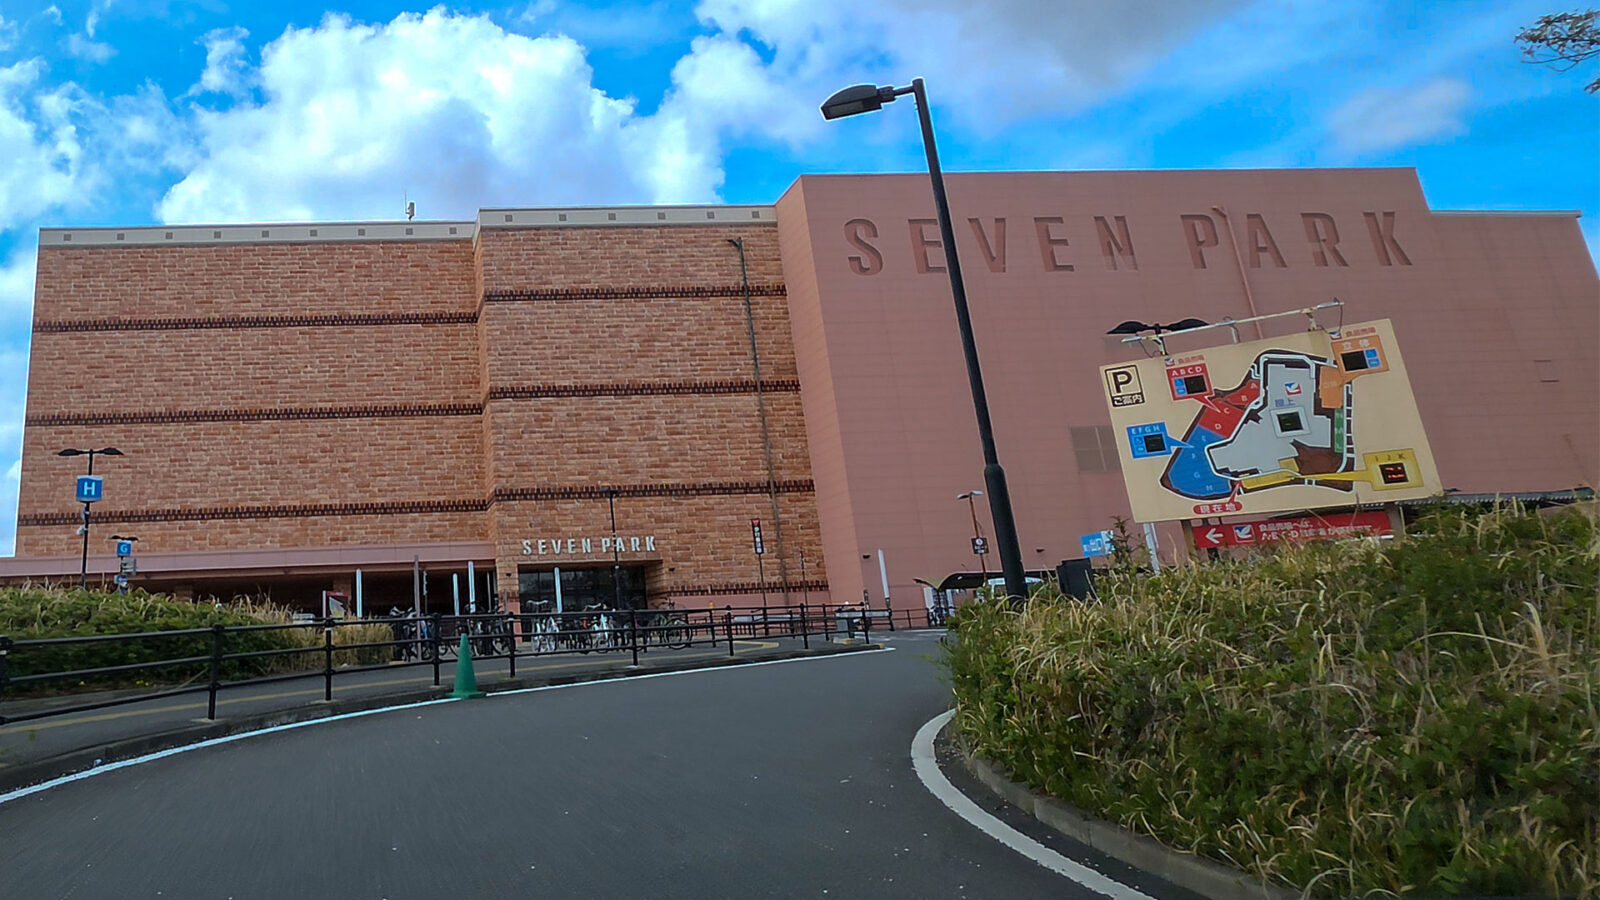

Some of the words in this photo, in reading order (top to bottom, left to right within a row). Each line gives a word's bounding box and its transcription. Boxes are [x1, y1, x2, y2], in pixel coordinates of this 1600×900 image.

[844, 215, 1139, 276] SEVEN
[1180, 211, 1412, 269] PARK
[1112, 370, 1132, 394] P
[1223, 407, 1231, 415] C
[1214, 423, 1222, 431] D
[83, 481, 96, 496] H
[120, 543, 128, 553] G
[522, 537, 592, 555] SEVEN
[601, 535, 656, 553] PARK
